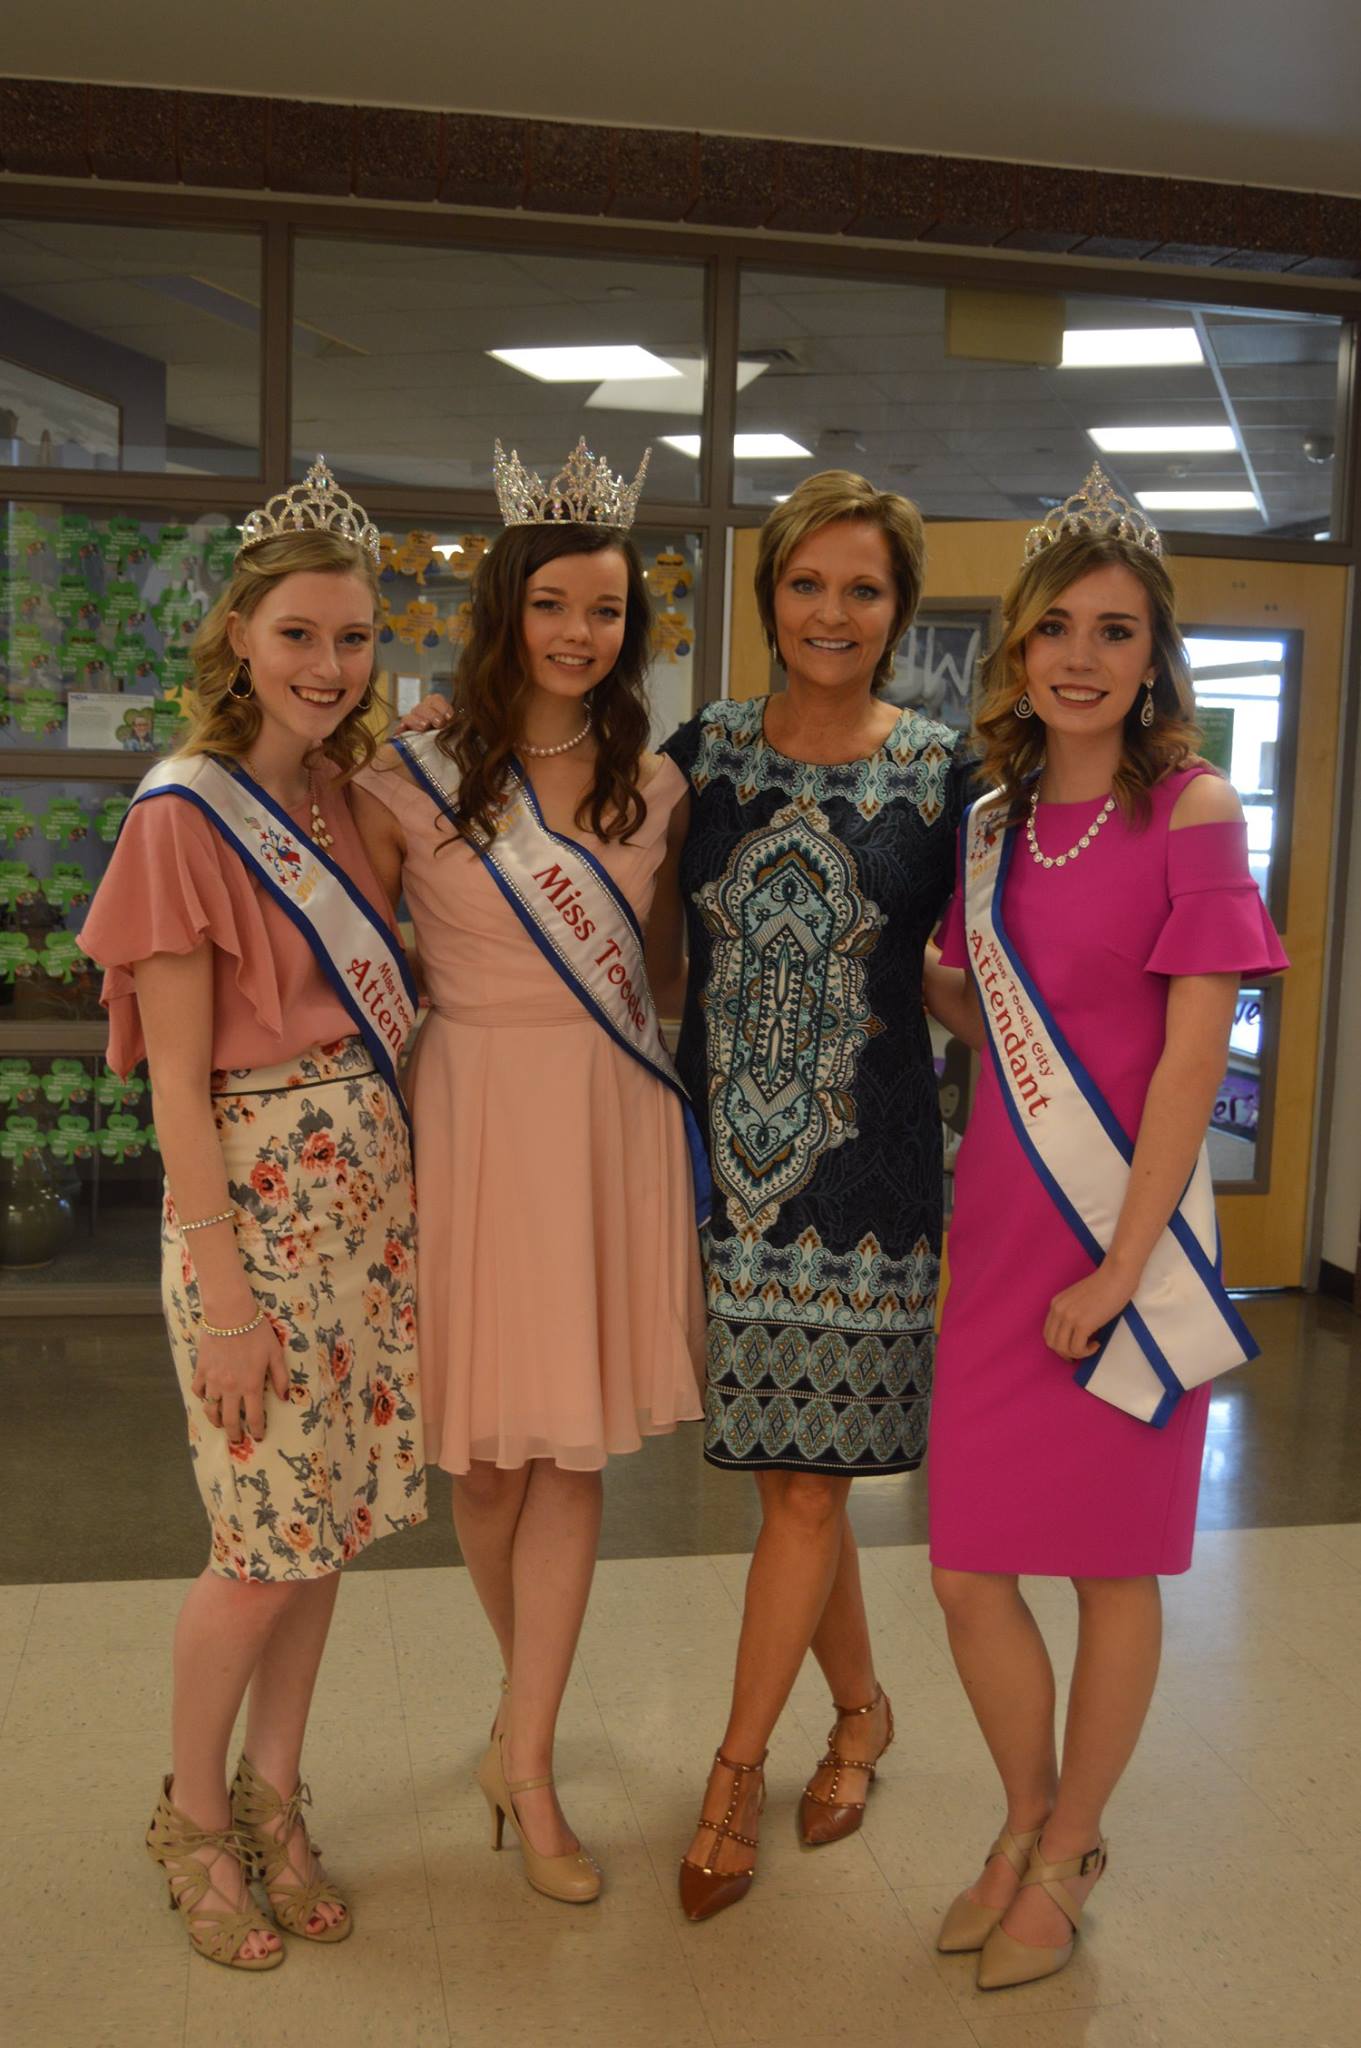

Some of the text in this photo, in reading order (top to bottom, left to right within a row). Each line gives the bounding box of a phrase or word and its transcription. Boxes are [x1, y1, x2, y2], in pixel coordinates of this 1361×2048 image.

[378, 961, 396, 996] Miss
[532, 863, 647, 1032] Miss Tooele
[989, 941, 1055, 1077] Miss Tooele City
[969, 929, 1052, 1119] Attendant
